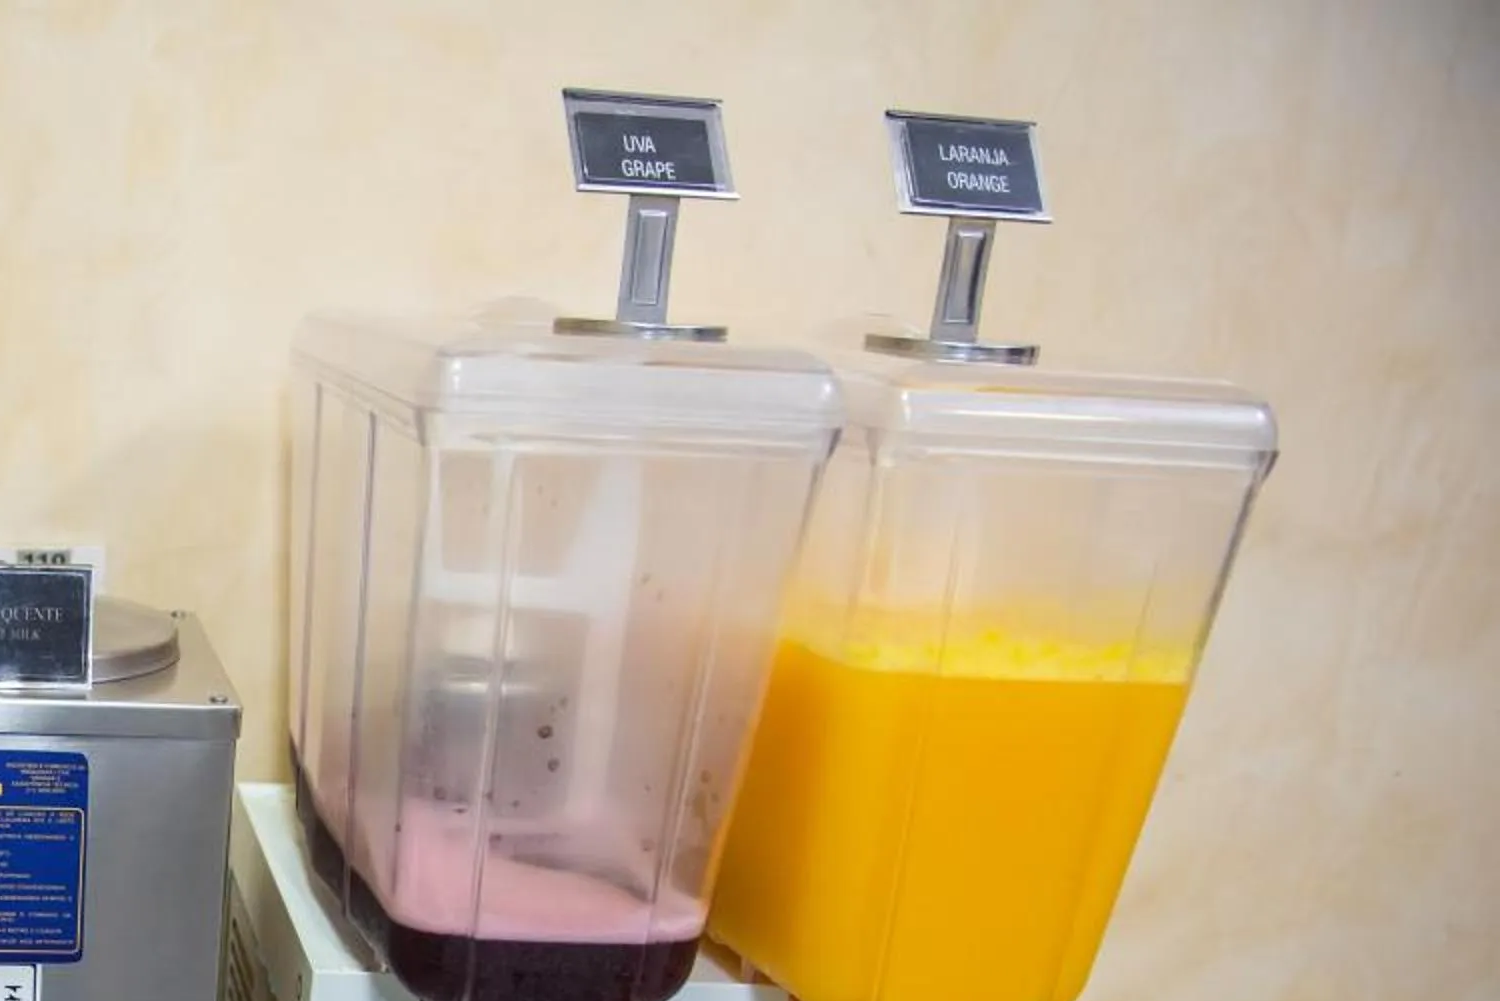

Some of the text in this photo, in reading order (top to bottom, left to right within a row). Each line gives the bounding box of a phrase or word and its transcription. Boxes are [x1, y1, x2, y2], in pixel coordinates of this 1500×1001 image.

[623, 135, 656, 153] UVA
[938, 143, 1010, 167] LARANJA
[621, 159, 677, 180] GRAPE
[947, 171, 1011, 193] ORANGE
[1, 606, 64, 623] QUENTE
